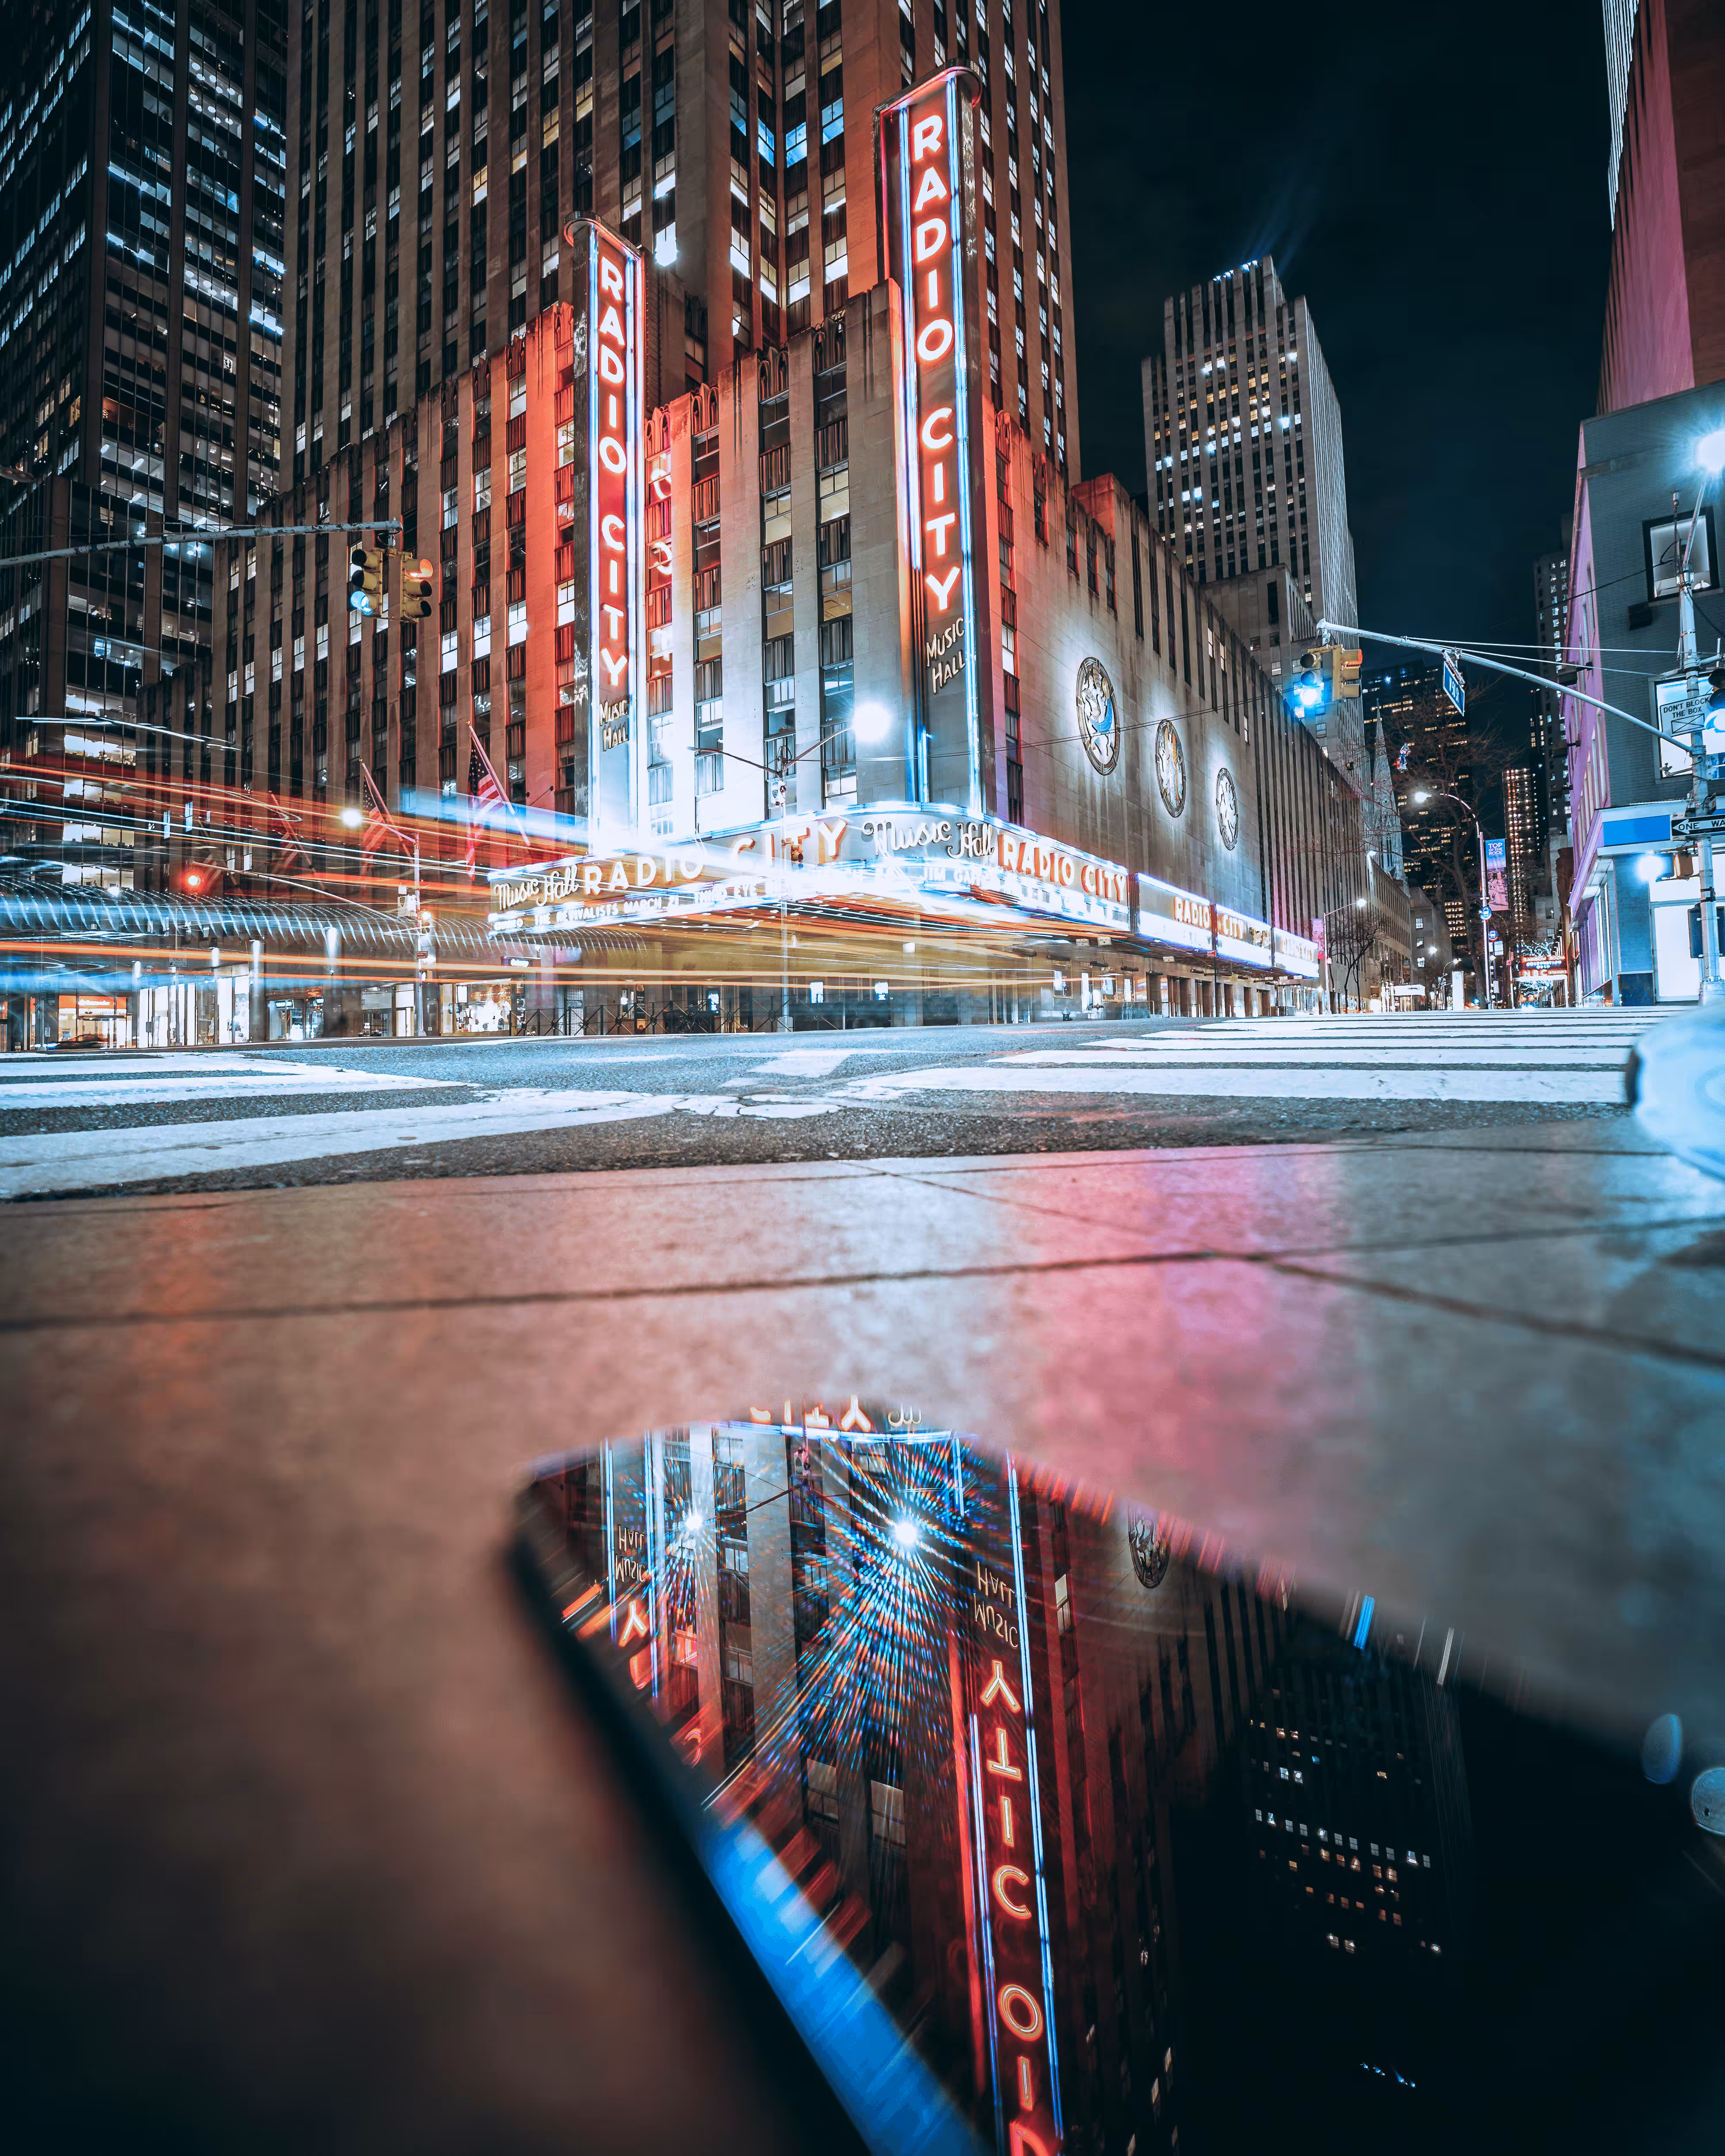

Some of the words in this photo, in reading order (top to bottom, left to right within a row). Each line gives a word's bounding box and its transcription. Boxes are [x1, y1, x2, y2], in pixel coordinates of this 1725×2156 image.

[913, 114, 953, 362] RADIO
[599, 256, 627, 474] RADIO
[921, 407, 960, 611] CITY
[600, 513, 628, 687] CITY
[1663, 703, 1683, 713] DON'T
[1686, 697, 1709, 708] BLOCK
[1672, 710, 1686, 718] THE
[1688, 706, 1703, 715] BOX
[494, 878, 539, 911] Music
[536, 864, 580, 907] Hall
[584, 852, 705, 895] RADIO
[862, 821, 952, 856] Music
[947, 821, 995, 859] Hall
[997, 834, 1075, 887] RADIO
[1081, 865, 1126, 903] CITY
[1678, 822, 1700, 830] ONE
[1173, 896, 1211, 929] RADIO
[1220, 913, 1244, 940] CITY
